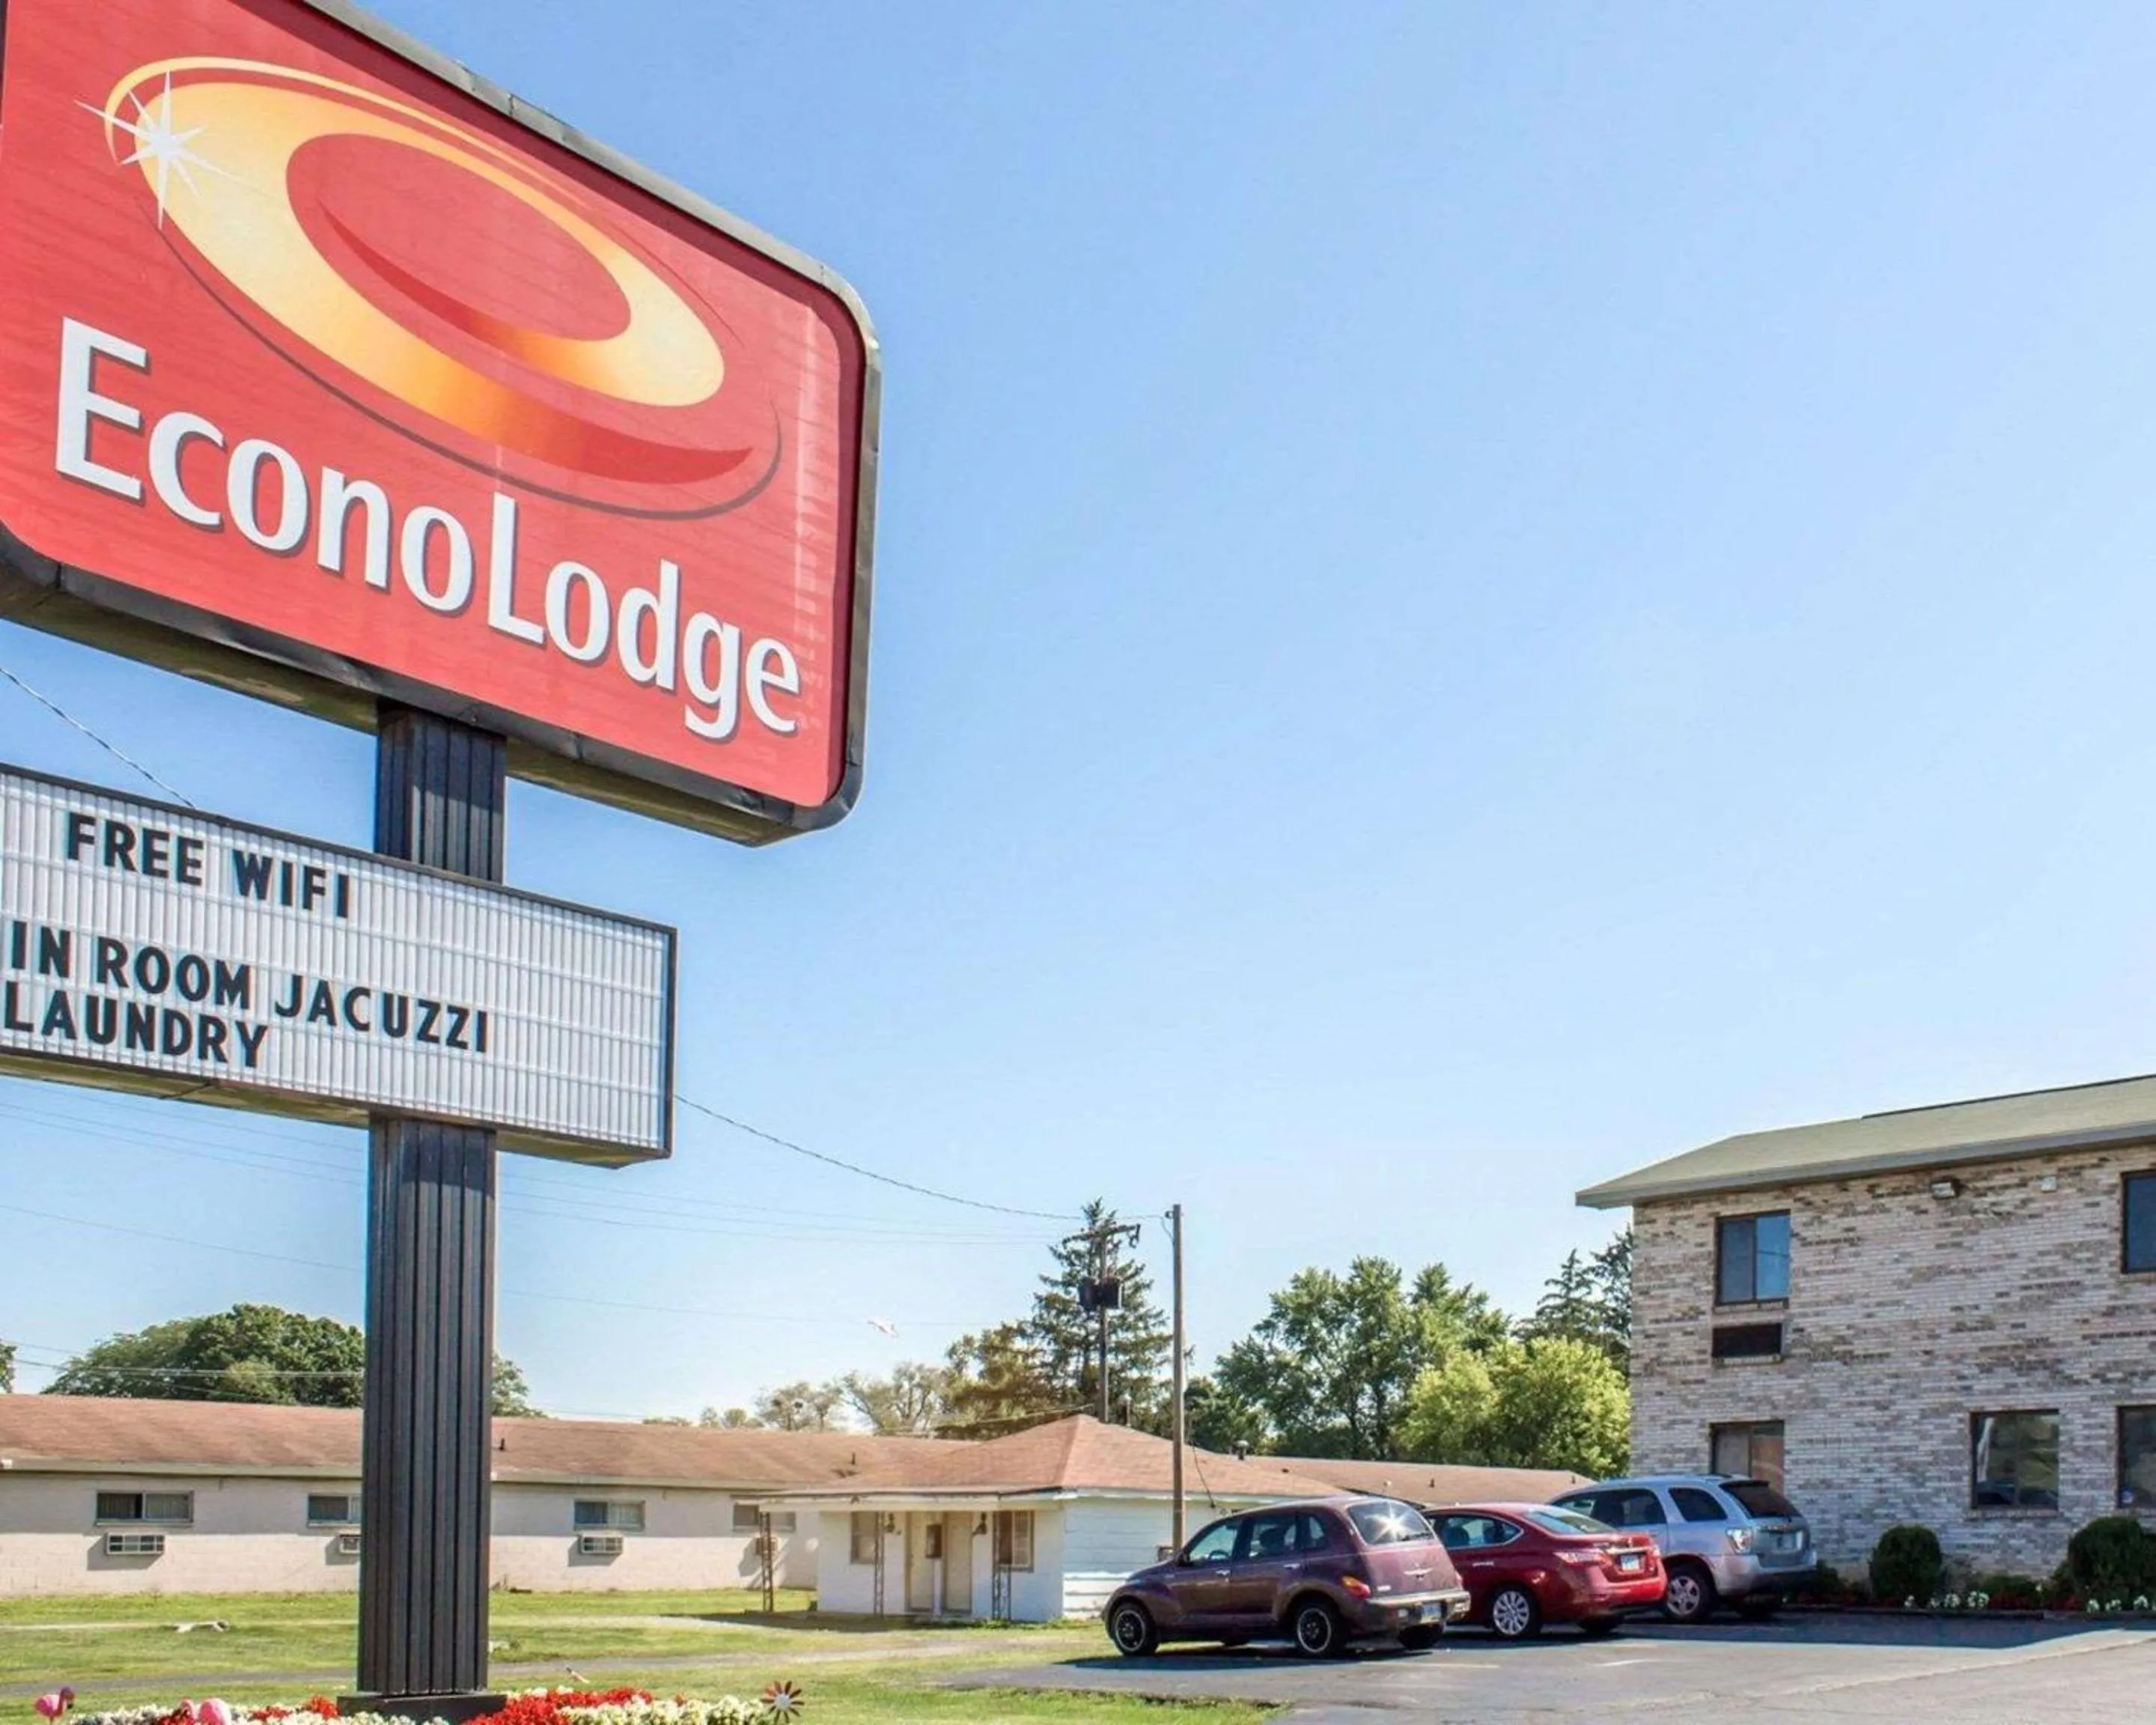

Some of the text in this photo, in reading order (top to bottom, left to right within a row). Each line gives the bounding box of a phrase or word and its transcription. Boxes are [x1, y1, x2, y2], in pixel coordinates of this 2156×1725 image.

[68, 812, 350, 918] FREE WIFI
[4, 981, 270, 1068] LAUNDRY
[13, 921, 488, 1052] IN ROOM JACUZZI
